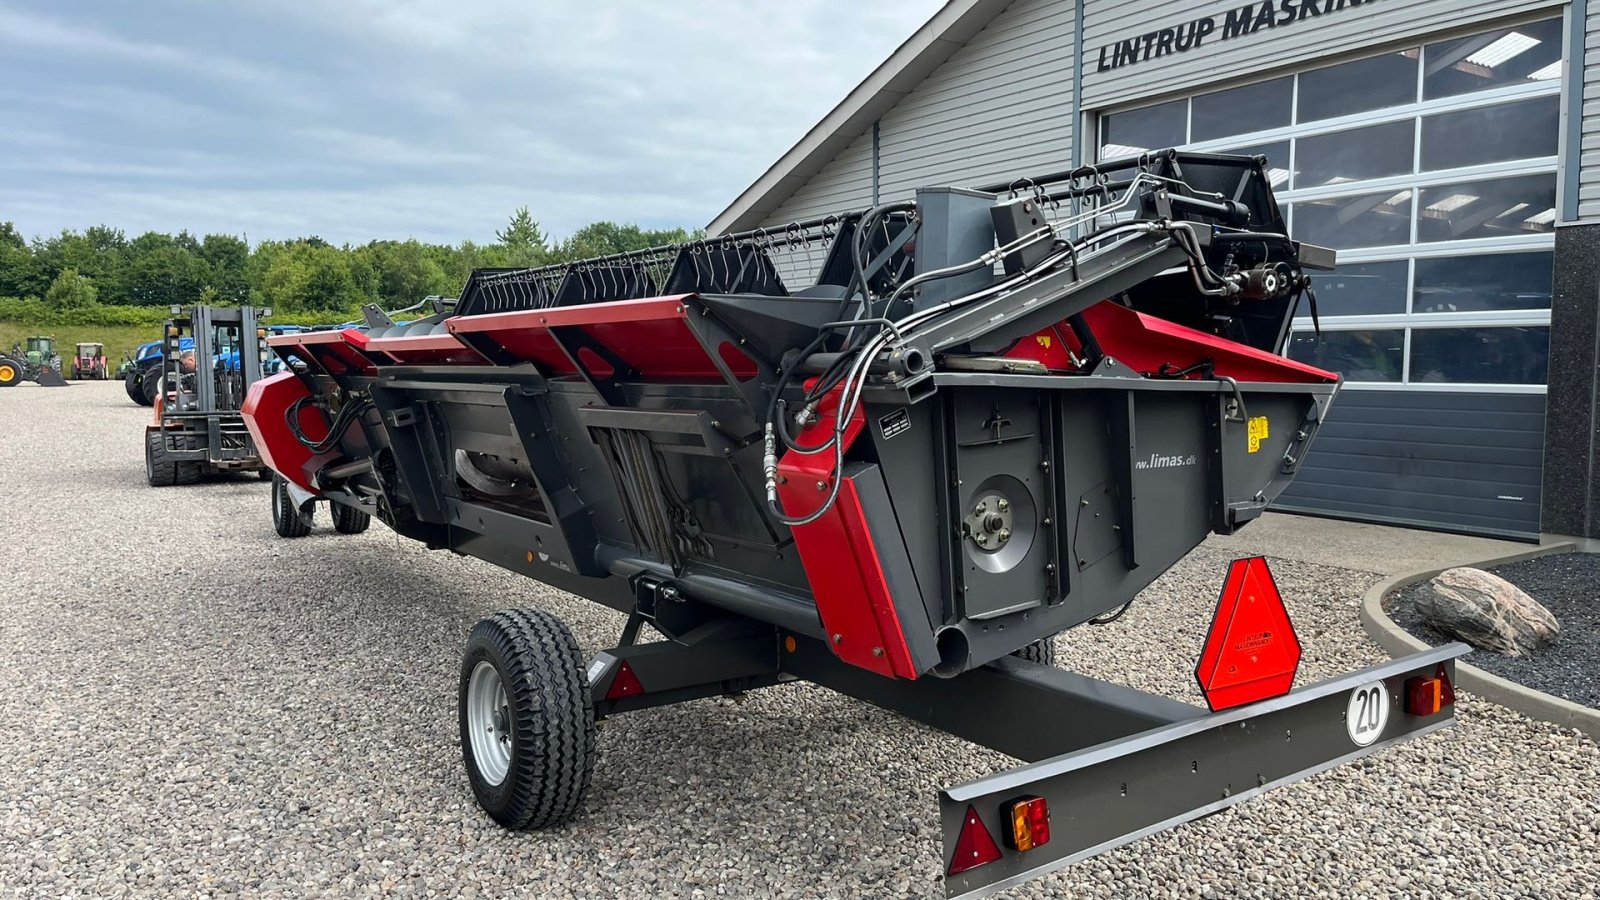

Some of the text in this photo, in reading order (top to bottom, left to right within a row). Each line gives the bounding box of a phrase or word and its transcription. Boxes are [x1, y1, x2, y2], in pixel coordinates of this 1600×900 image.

[1097, 0, 1378, 72] LINTRUP MASK
[1356, 686, 1381, 735] 20
